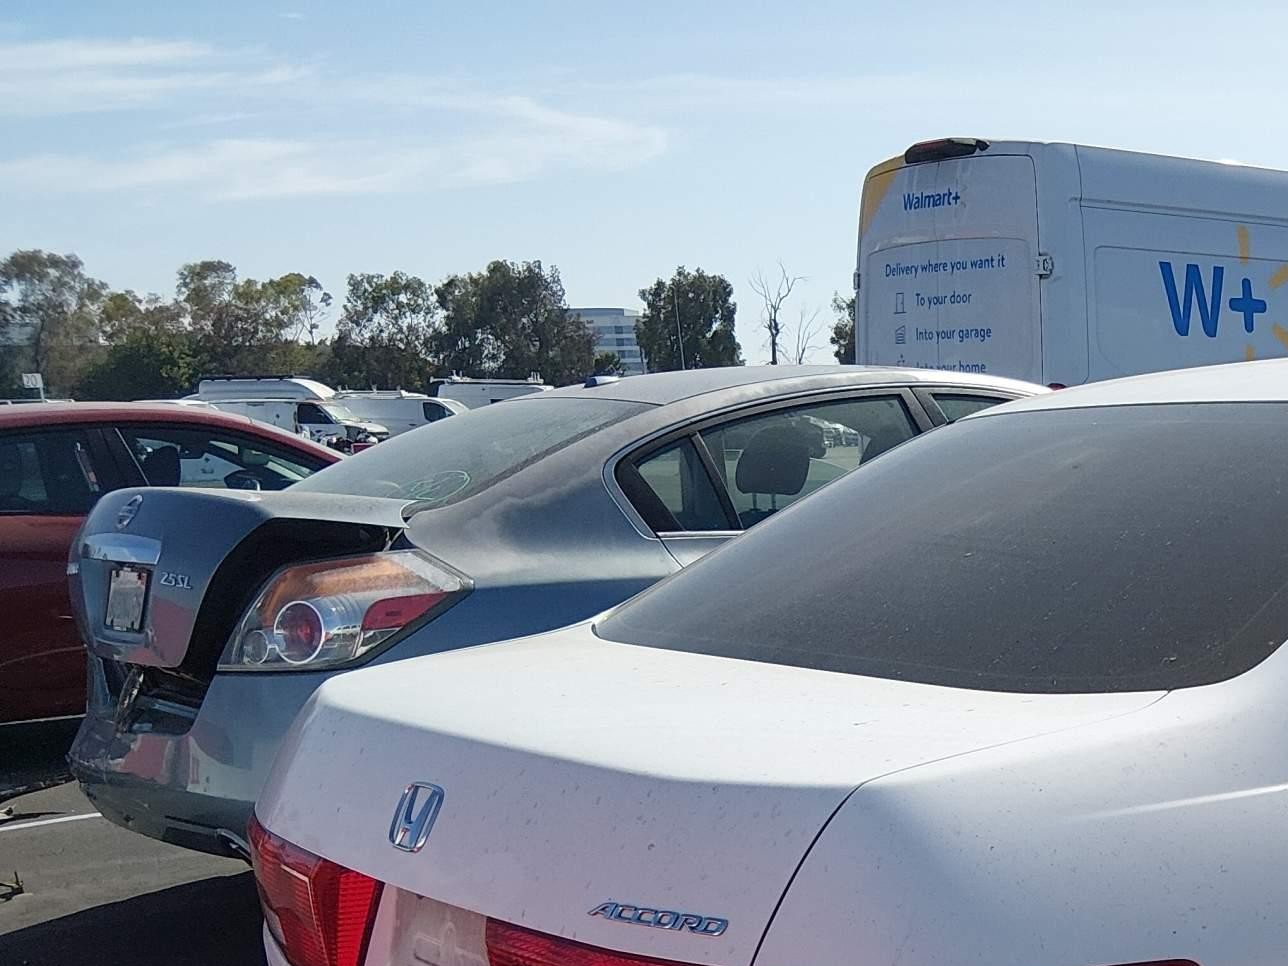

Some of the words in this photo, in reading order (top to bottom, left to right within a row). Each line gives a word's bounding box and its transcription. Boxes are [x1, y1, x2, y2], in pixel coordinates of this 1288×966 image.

[903, 188, 961, 211] Walmart+
[885, 263, 919, 278] Delivery
[921, 259, 948, 273] where
[950, 260, 967, 276] you
[970, 256, 995, 270] want
[997, 253, 1006, 267] it
[915, 293, 926, 306] To
[927, 295, 947, 309] your
[949, 290, 972, 304] door
[916, 328, 933, 341] Into
[936, 330, 956, 344] your
[958, 327, 992, 342] garage
[959, 360, 987, 373] home
[587, 902, 729, 937] ACCORD
